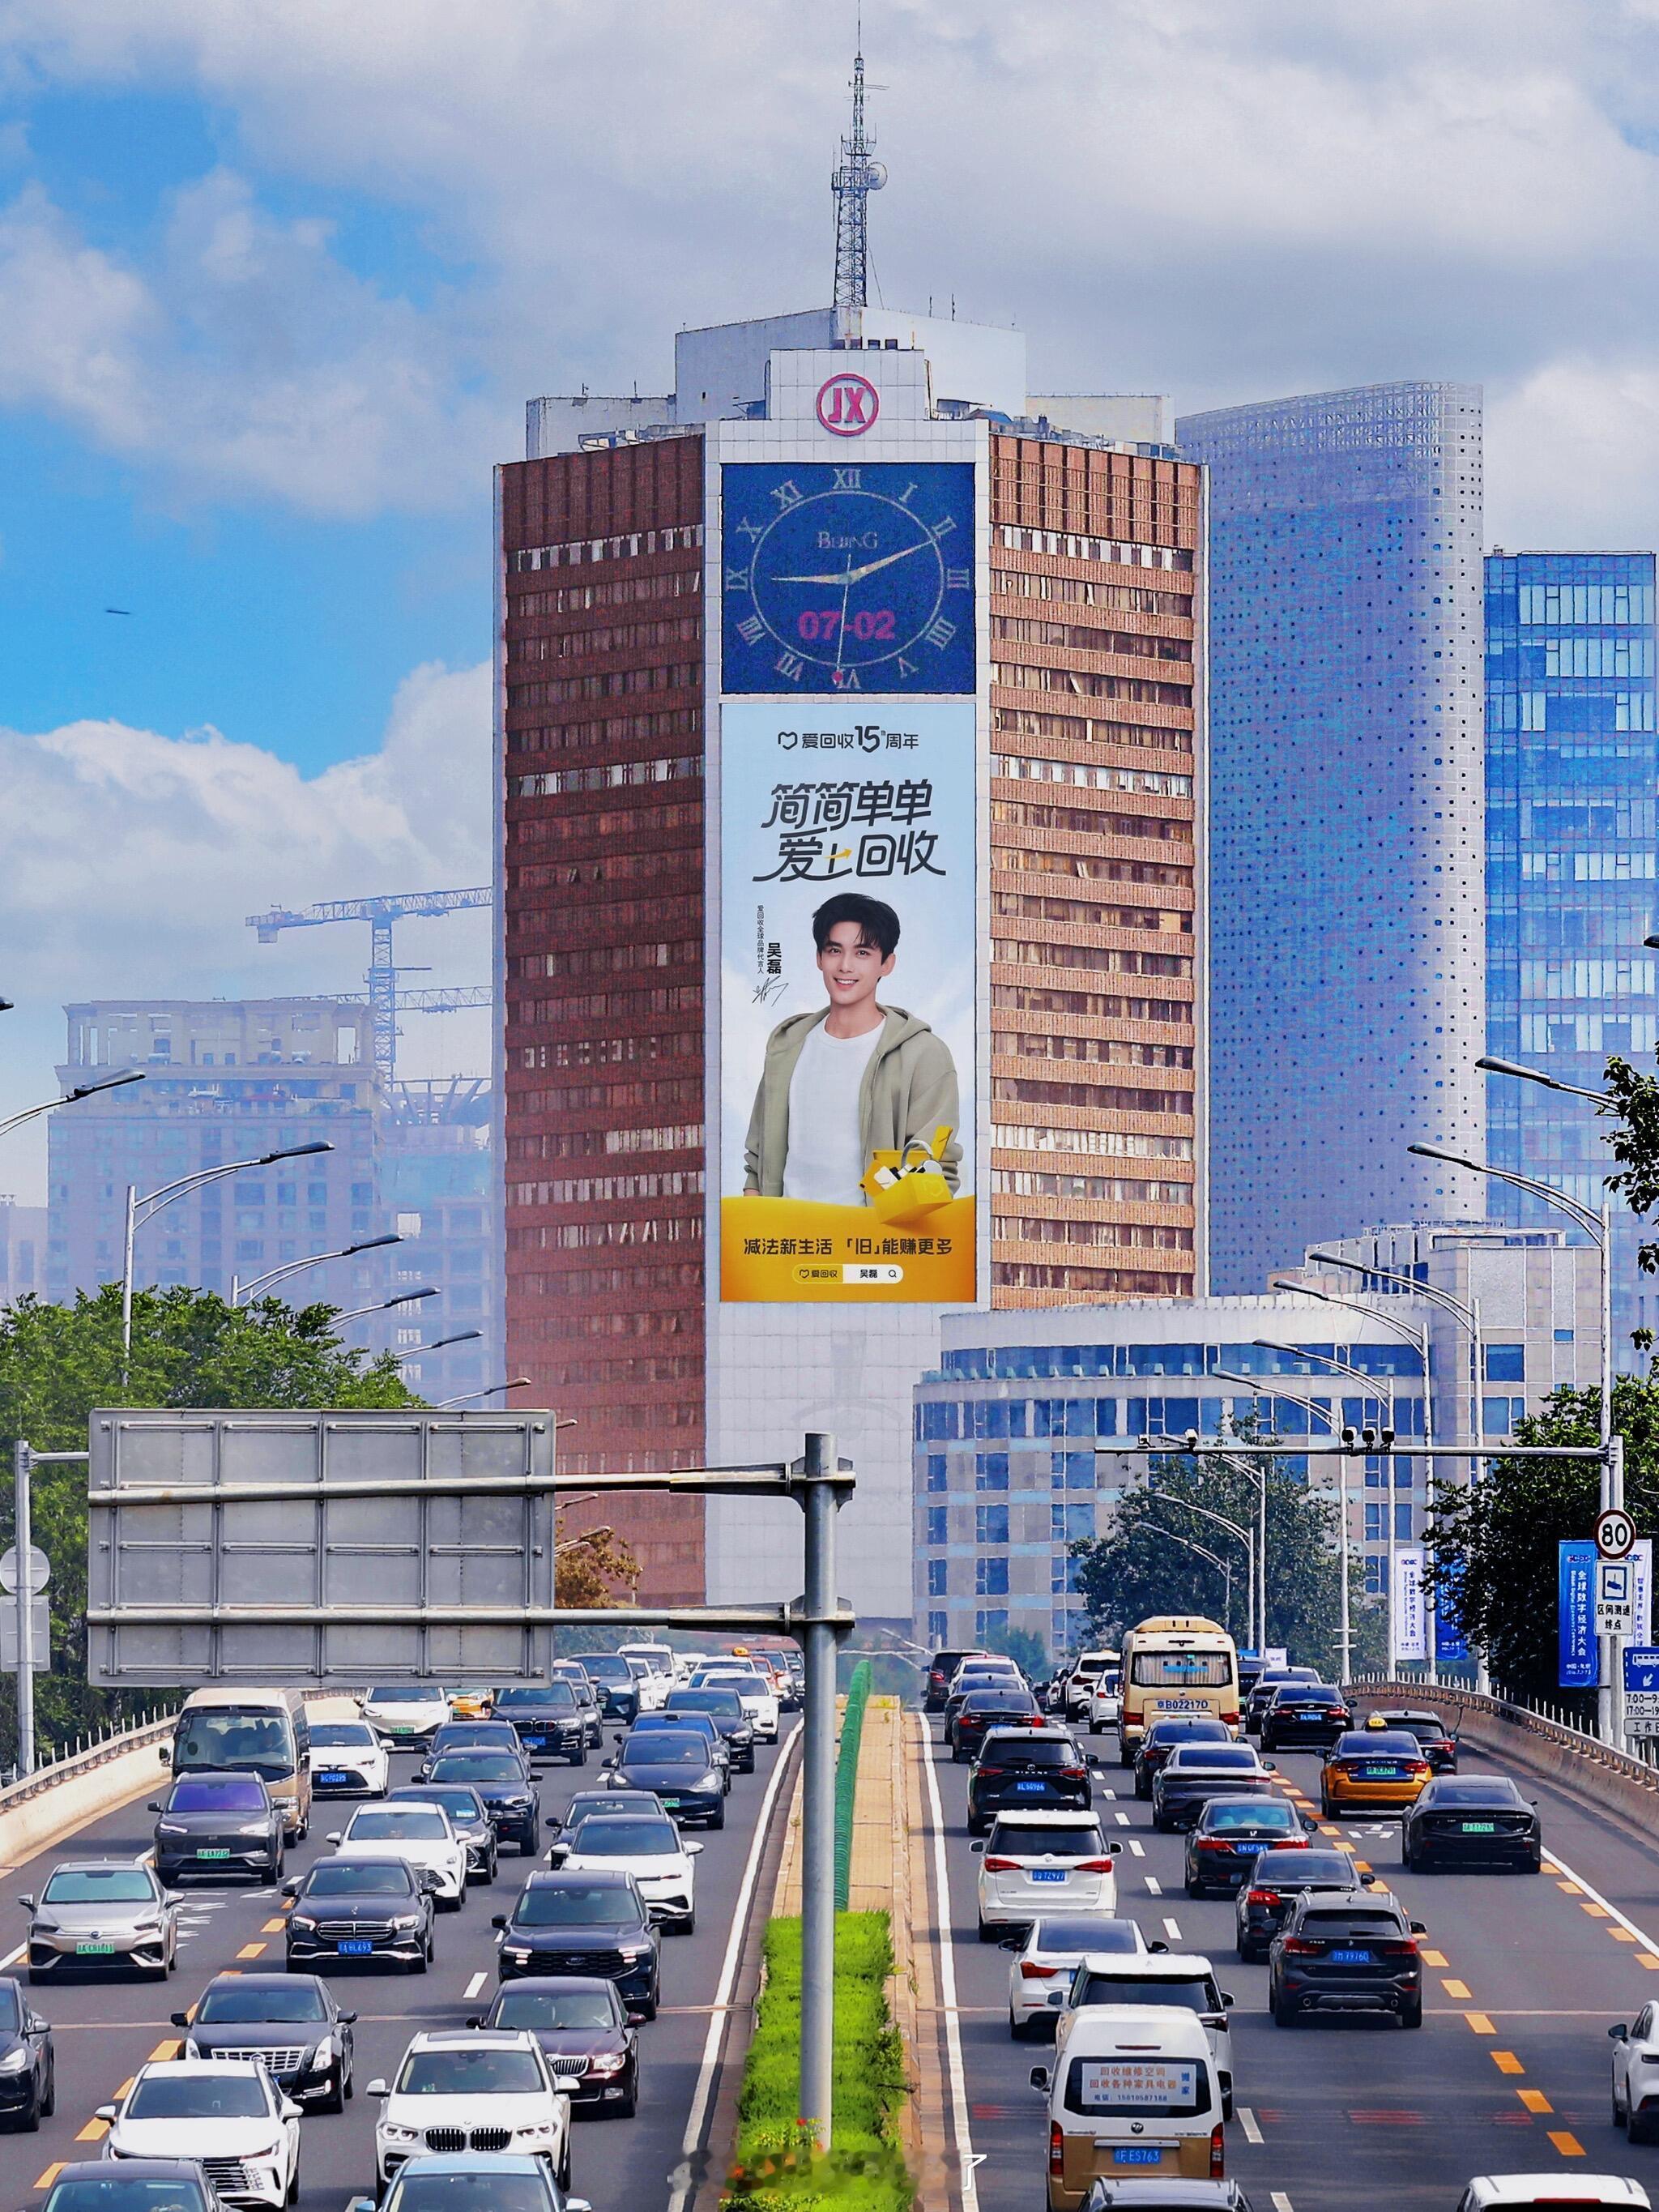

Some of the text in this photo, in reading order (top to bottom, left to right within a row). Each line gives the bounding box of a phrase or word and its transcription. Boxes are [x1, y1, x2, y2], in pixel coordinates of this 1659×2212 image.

[828, 386, 866, 423] JX
[834, 468, 861, 489] XII
[770, 480, 804, 510] XI
[736, 516, 763, 543] X
[932, 515, 957, 540] II
[726, 570, 748, 591] IX
[947, 568, 970, 590] III
[798, 611, 896, 641] 07-02
[898, 656, 919, 679] V
[761, 778, 933, 831] 简简单单
[752, 826, 947, 882] 爱上回收
[766, 942, 783, 975] 吴磊
[744, 1238, 833, 1255] 减法新生活
[811, 1269, 838, 1279] 爱回收
[859, 1269, 879, 1279] 吴磊
[1601, 1522, 1628, 1548] 80
[1577, 1569, 1588, 1656] 全球数字经济大会
[1597, 1603, 1631, 1616] 区间测速
[1605, 1619, 1622, 1630] 终点
